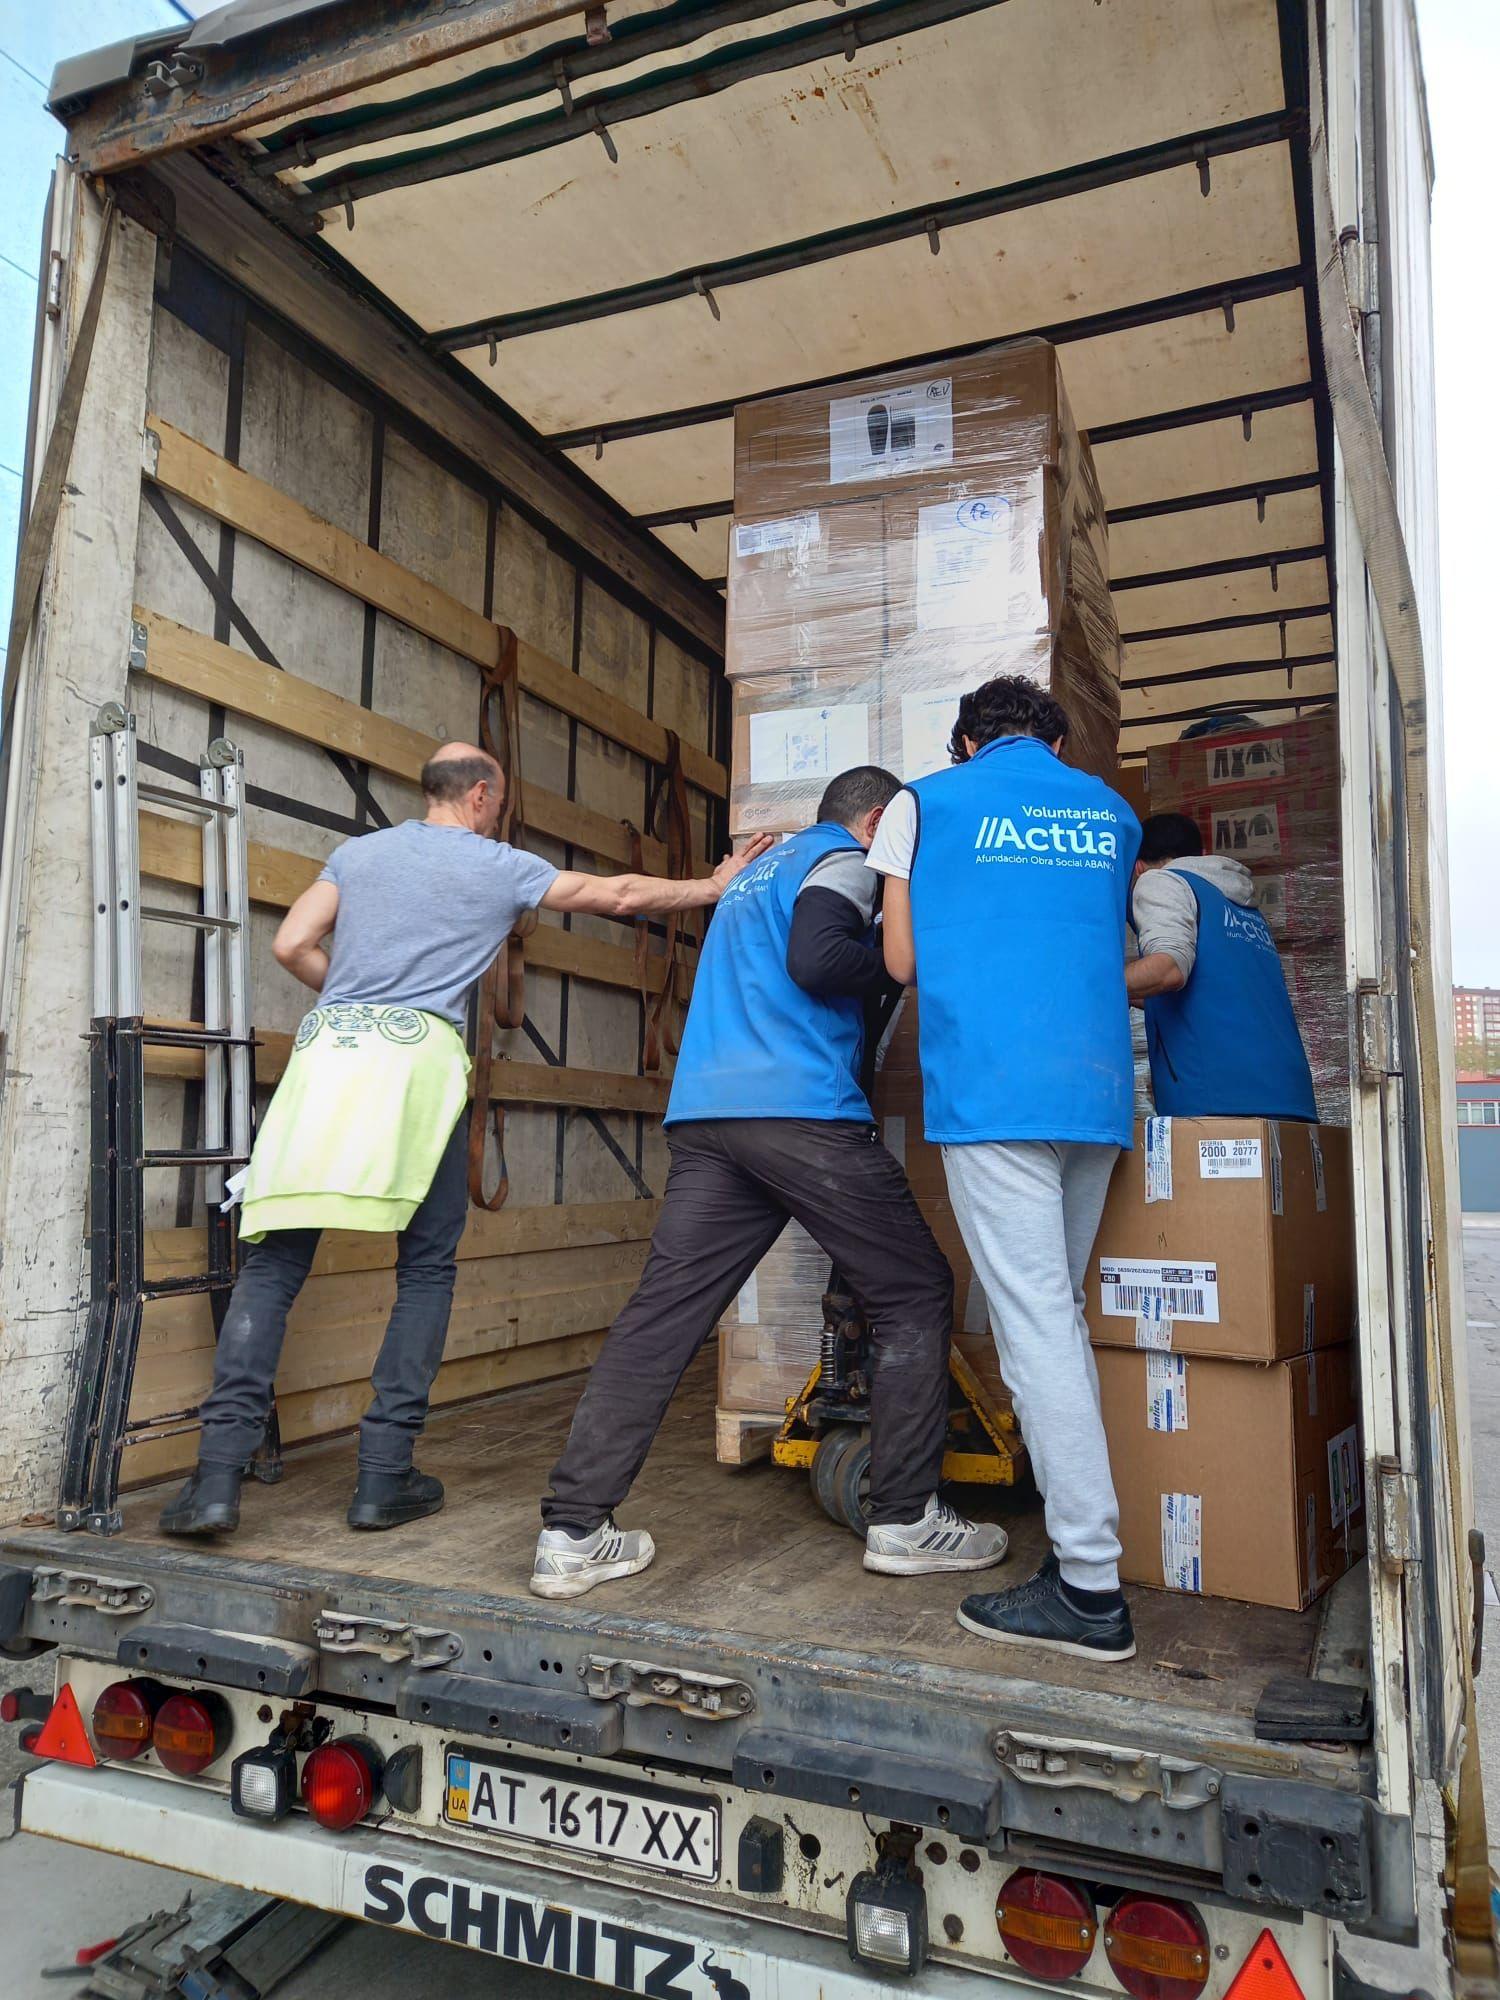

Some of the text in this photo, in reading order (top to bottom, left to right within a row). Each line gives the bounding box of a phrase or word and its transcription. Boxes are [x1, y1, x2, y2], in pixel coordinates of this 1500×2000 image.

[1022, 805, 1117, 823] Voluntariado
[976, 854, 1028, 865] Afundación
[1030, 855, 1053, 866] Obra
[1056, 857, 1083, 868] Social
[1201, 1145, 1258, 1158] 2000 20777
[451, 1799, 467, 1813] UA
[471, 1771, 702, 1866] AT 1617 XX
[364, 1864, 696, 2000] SCHMITZ
